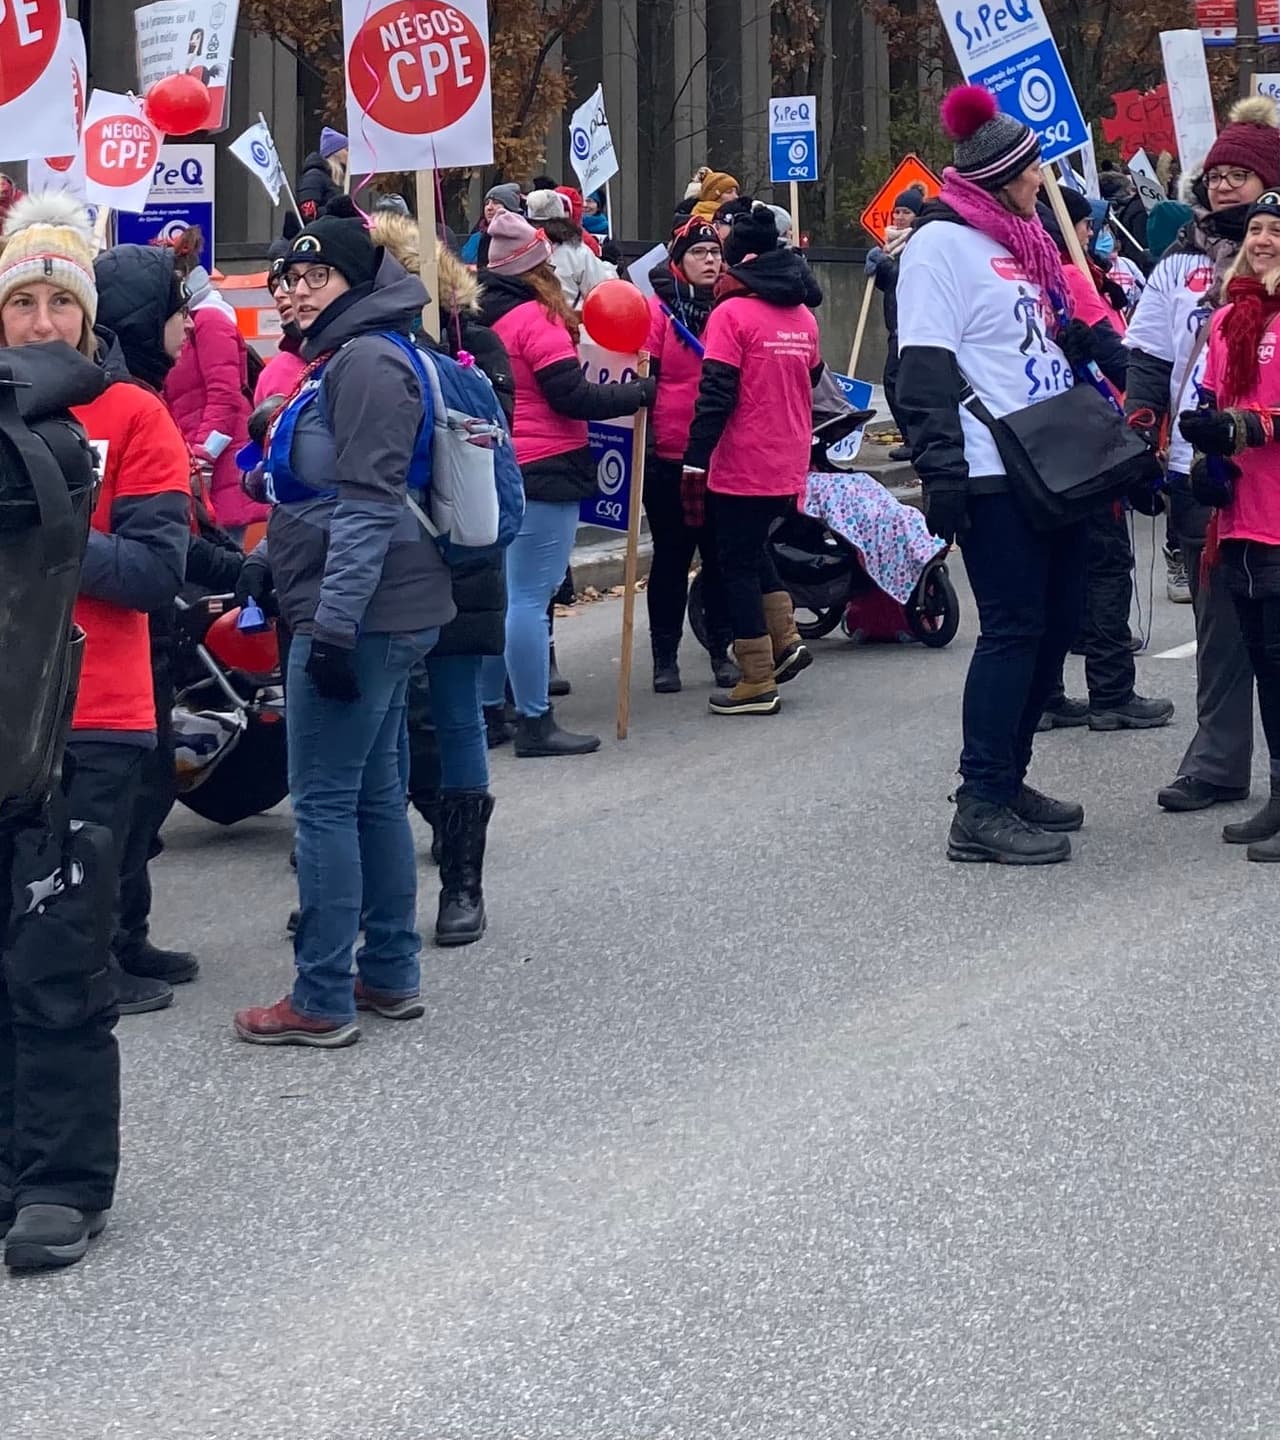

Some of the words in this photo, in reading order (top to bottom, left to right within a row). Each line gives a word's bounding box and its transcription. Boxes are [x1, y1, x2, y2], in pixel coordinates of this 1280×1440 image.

[379, 8, 464, 52] NÉGOS
[388, 35, 473, 103] CPE
[774, 103, 810, 121] SiPeQ
[102, 121, 151, 141] NÉGOS
[100, 140, 152, 169] CPE
[153, 158, 203, 185] PeQ
[788, 166, 808, 177] CSQ
[1025, 357, 1072, 396] SiPe
[596, 500, 622, 521] CSQ
